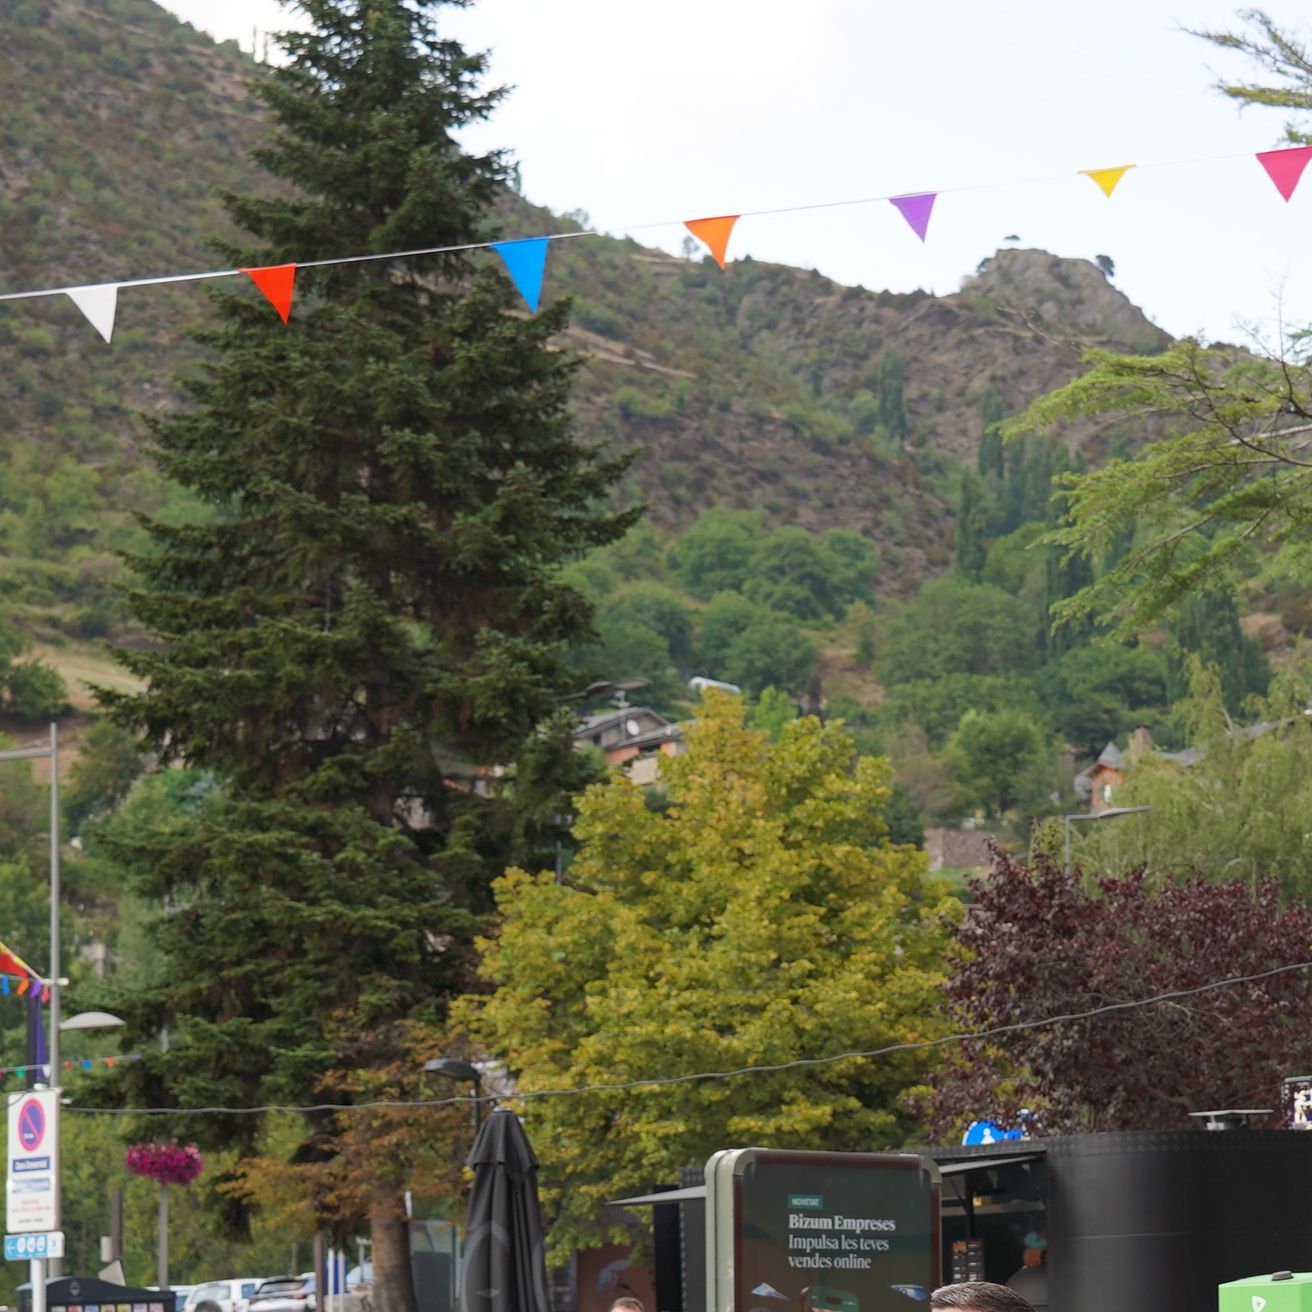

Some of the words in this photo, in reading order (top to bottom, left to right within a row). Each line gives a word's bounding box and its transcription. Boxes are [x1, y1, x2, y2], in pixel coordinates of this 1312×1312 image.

[789, 1213, 832, 1229] Bizum
[833, 1215, 896, 1234] Empreses
[789, 1234, 839, 1252] Impulsa
[841, 1234, 858, 1250] les
[859, 1237, 889, 1250] teves
[788, 1252, 832, 1269] vendes
[833, 1253, 872, 1269] online
